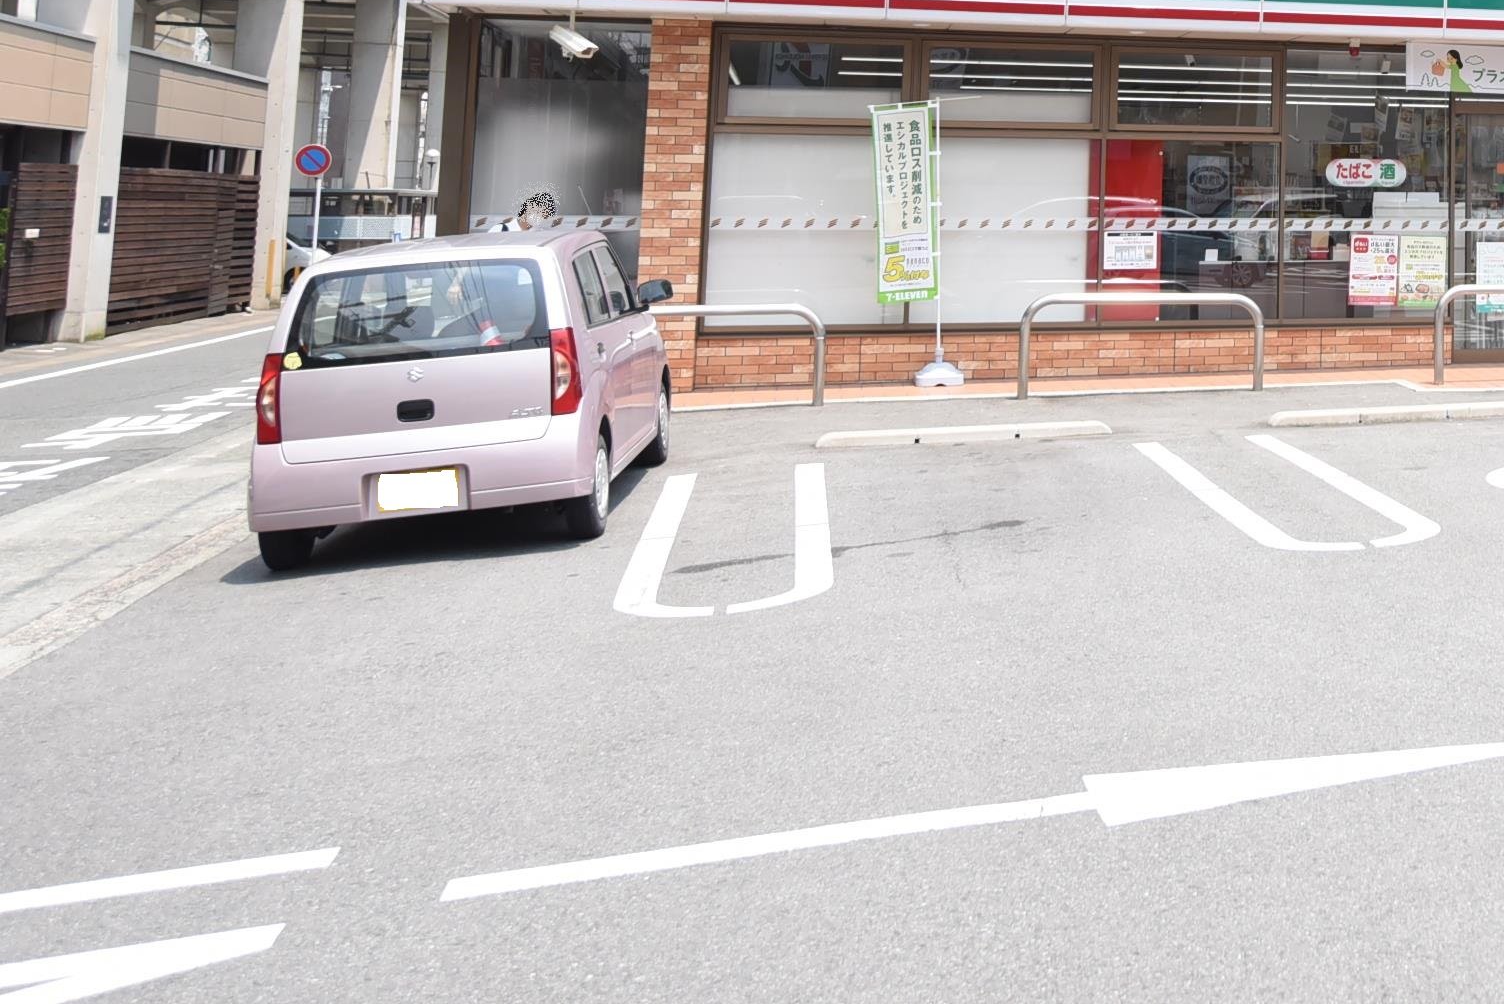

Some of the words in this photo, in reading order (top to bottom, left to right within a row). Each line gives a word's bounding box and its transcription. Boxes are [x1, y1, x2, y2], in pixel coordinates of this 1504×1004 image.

[909, 119, 922, 225] 食品ロス削減のため
[1336, 162, 1373, 180] たばこ
[1380, 163, 1396, 180] 酒
